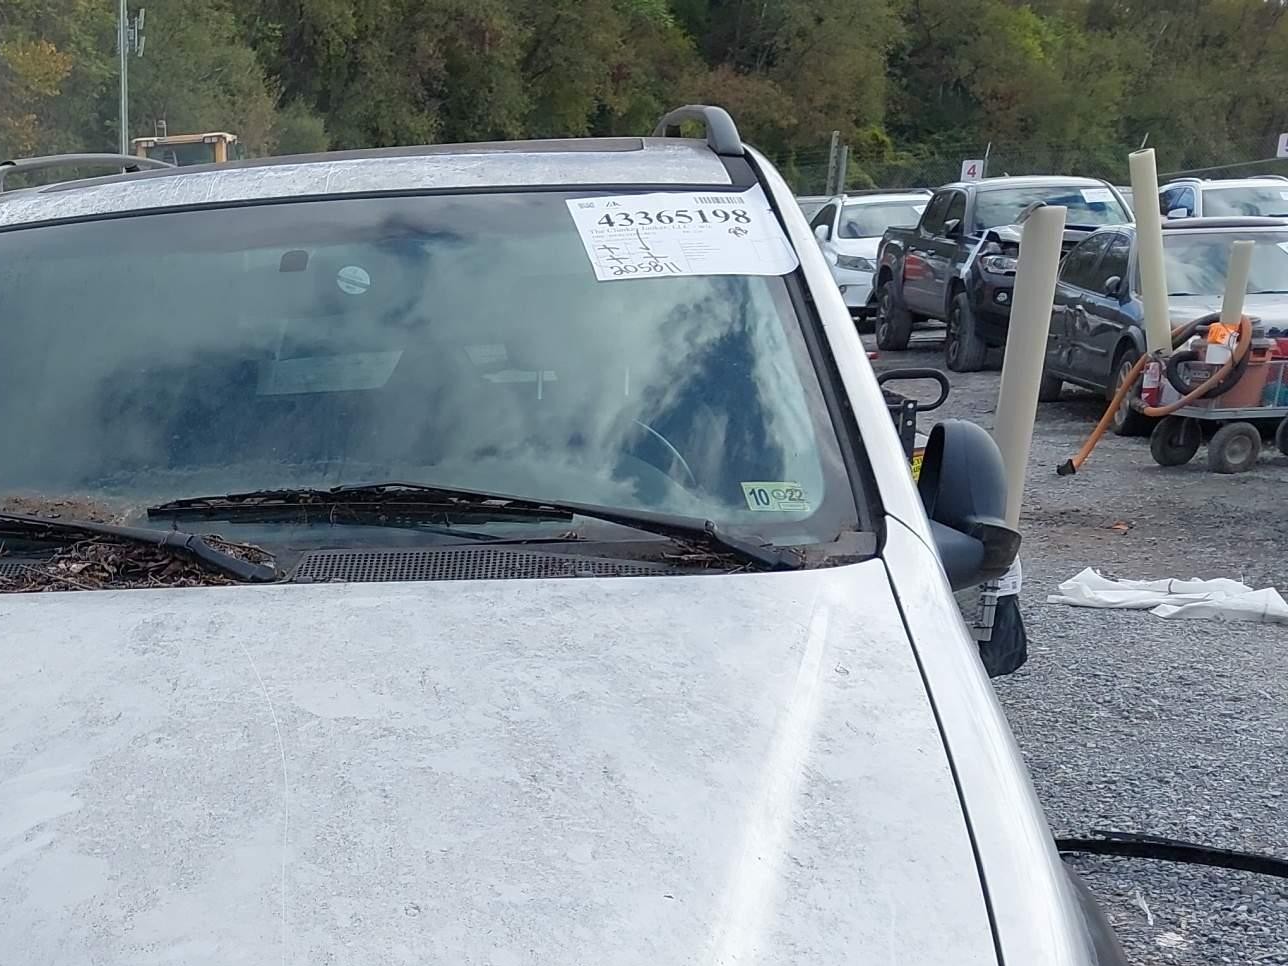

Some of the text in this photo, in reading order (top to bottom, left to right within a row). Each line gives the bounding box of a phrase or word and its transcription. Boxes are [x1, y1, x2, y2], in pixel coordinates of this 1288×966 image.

[967, 164, 977, 178] 4
[597, 208, 752, 227] 43365198
[749, 487, 770, 506] 10
